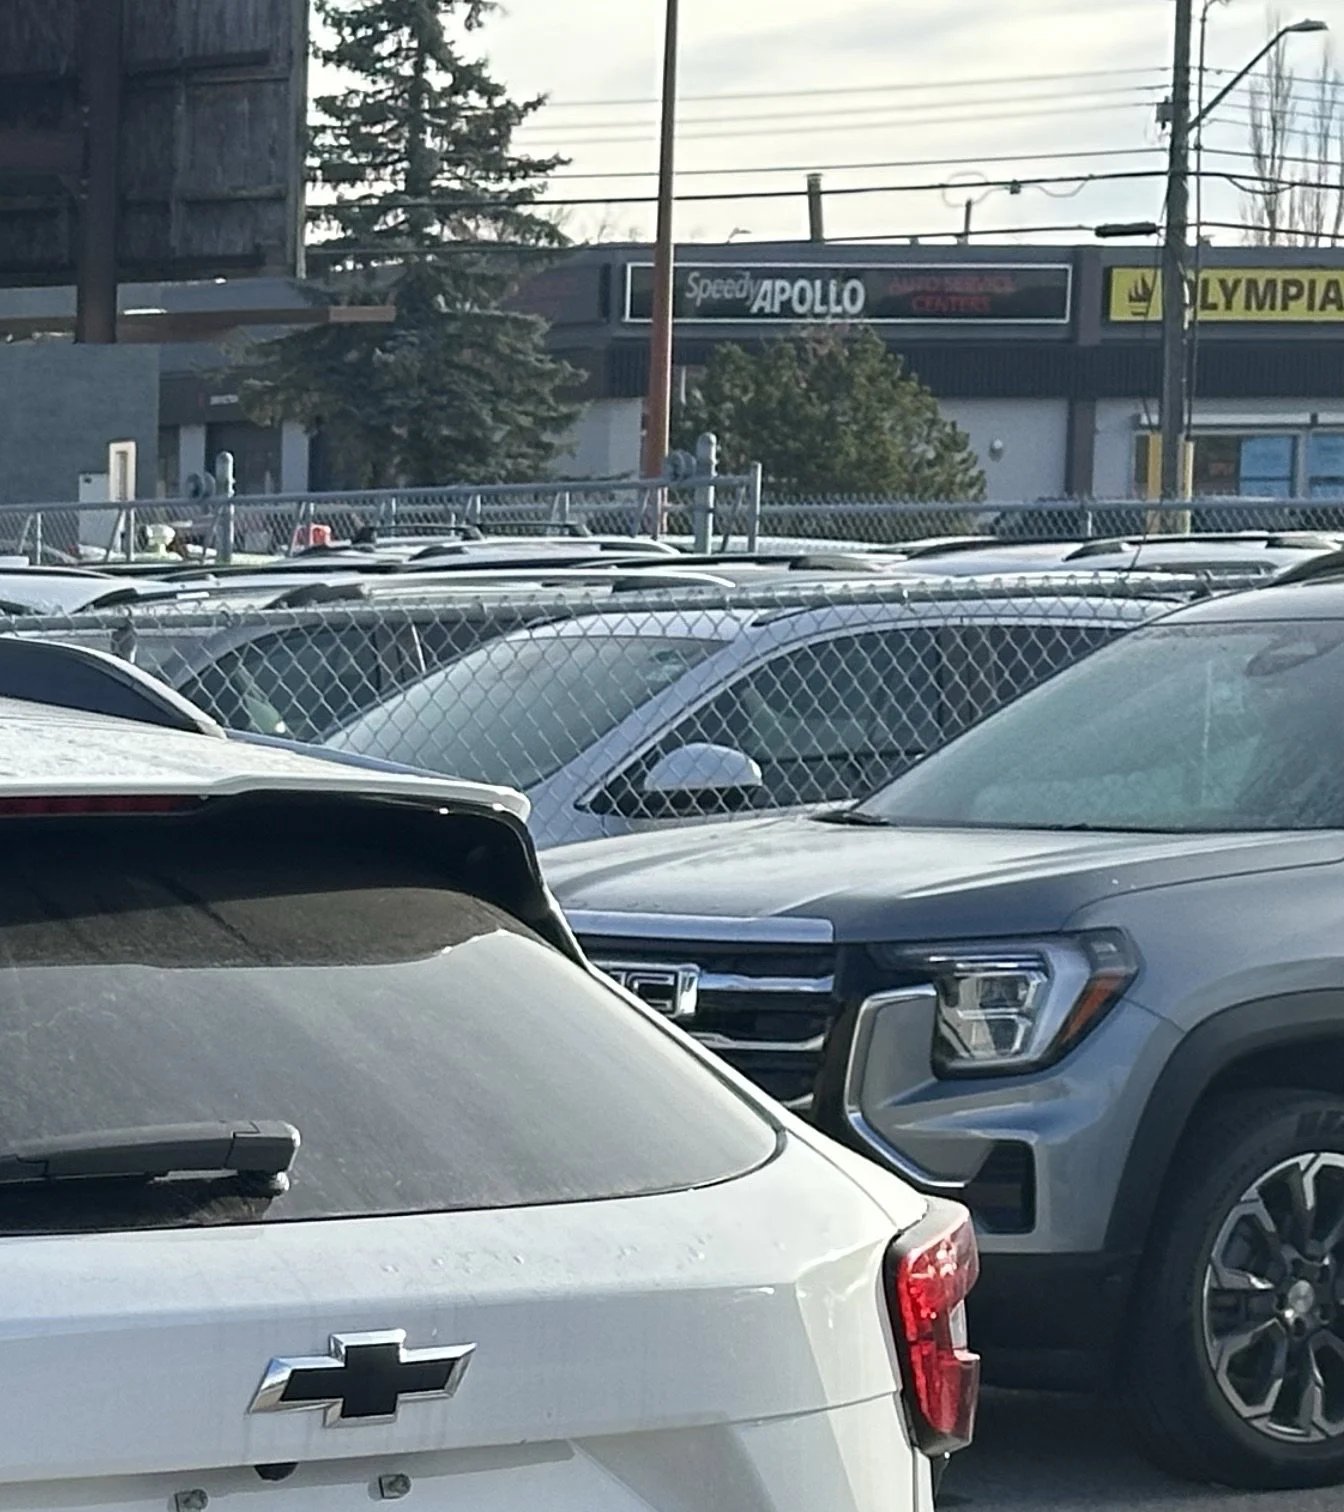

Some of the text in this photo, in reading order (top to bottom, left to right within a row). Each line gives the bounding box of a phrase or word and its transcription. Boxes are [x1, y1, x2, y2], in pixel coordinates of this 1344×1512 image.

[685, 271, 866, 315] Speedy APOLLO
[1188, 277, 1344, 312] LYMPIA
